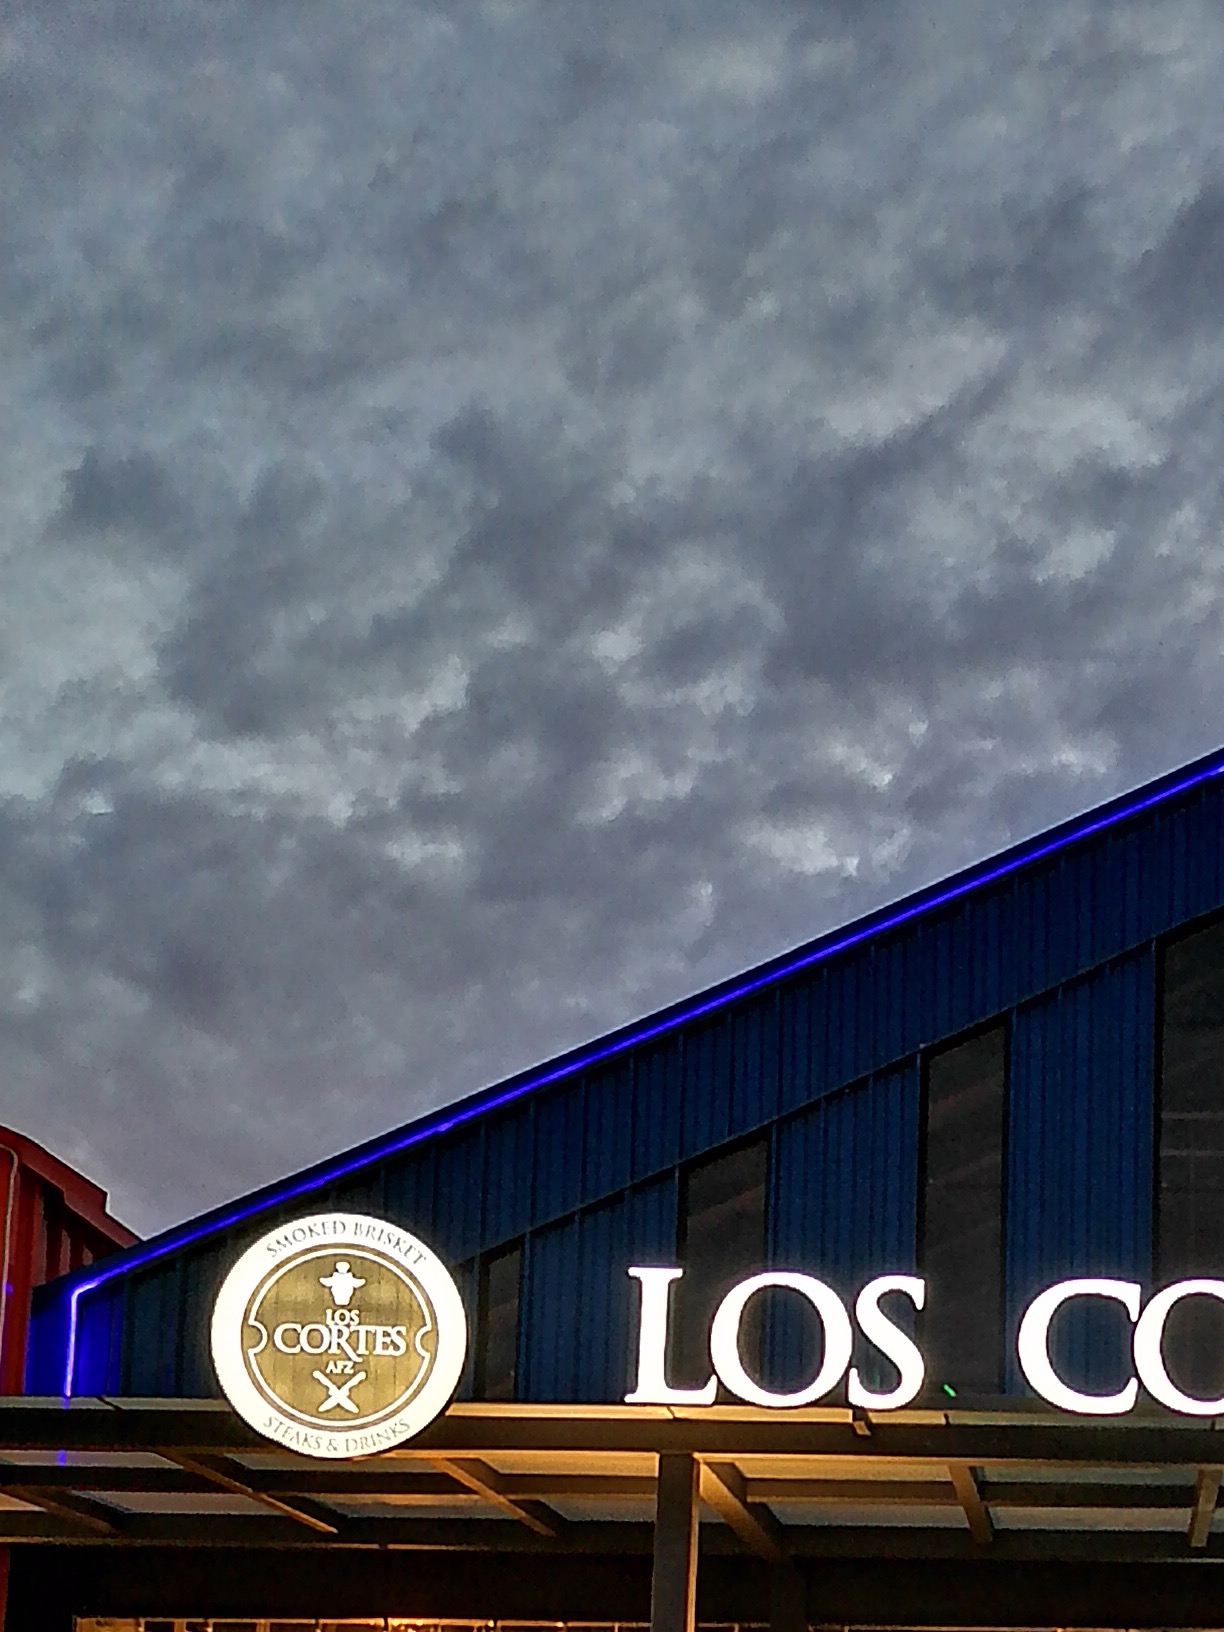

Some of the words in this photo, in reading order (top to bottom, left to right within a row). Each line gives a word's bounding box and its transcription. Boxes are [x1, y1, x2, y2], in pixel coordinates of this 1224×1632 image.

[266, 1220, 346, 1258] SMOKED
[354, 1222, 427, 1265] BRISKET
[325, 1308, 360, 1326] LOS
[273, 1323, 407, 1362] CORTES
[624, 1267, 925, 1410] LOS
[326, 1361, 355, 1374] AFZ
[263, 1416, 322, 1450] STEAKS
[326, 1437, 339, 1452] &
[345, 1418, 411, 1452] DRINKS
